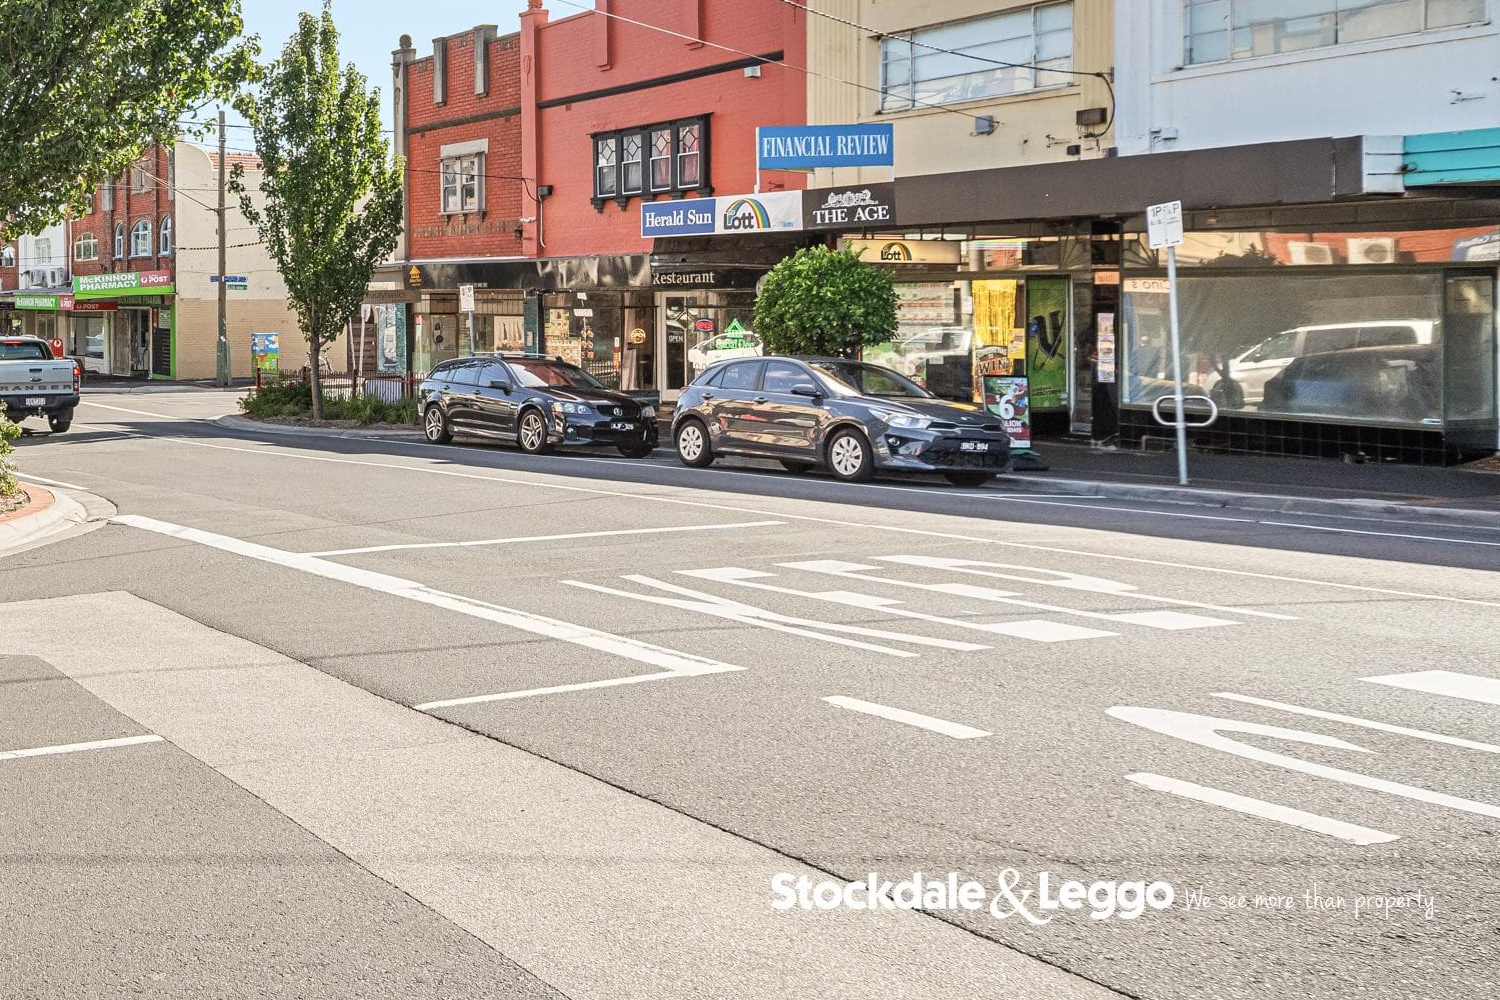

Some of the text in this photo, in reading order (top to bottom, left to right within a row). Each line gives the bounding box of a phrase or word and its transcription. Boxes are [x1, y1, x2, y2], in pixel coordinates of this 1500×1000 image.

[762, 134, 889, 158] FINANCIAL REVIEW
[645, 209, 712, 229] Herald Sun
[723, 212, 754, 230] Lott
[813, 205, 890, 224] THE AGE
[880, 250, 902, 261] Lott
[79, 273, 135, 285] McKINNON
[148, 275, 168, 284] POST
[652, 271, 715, 285] Restaurant
[79, 280, 138, 291] PHARMACY
[668, 334, 684, 343] OPEN
[977, 358, 1008, 373] WIN
